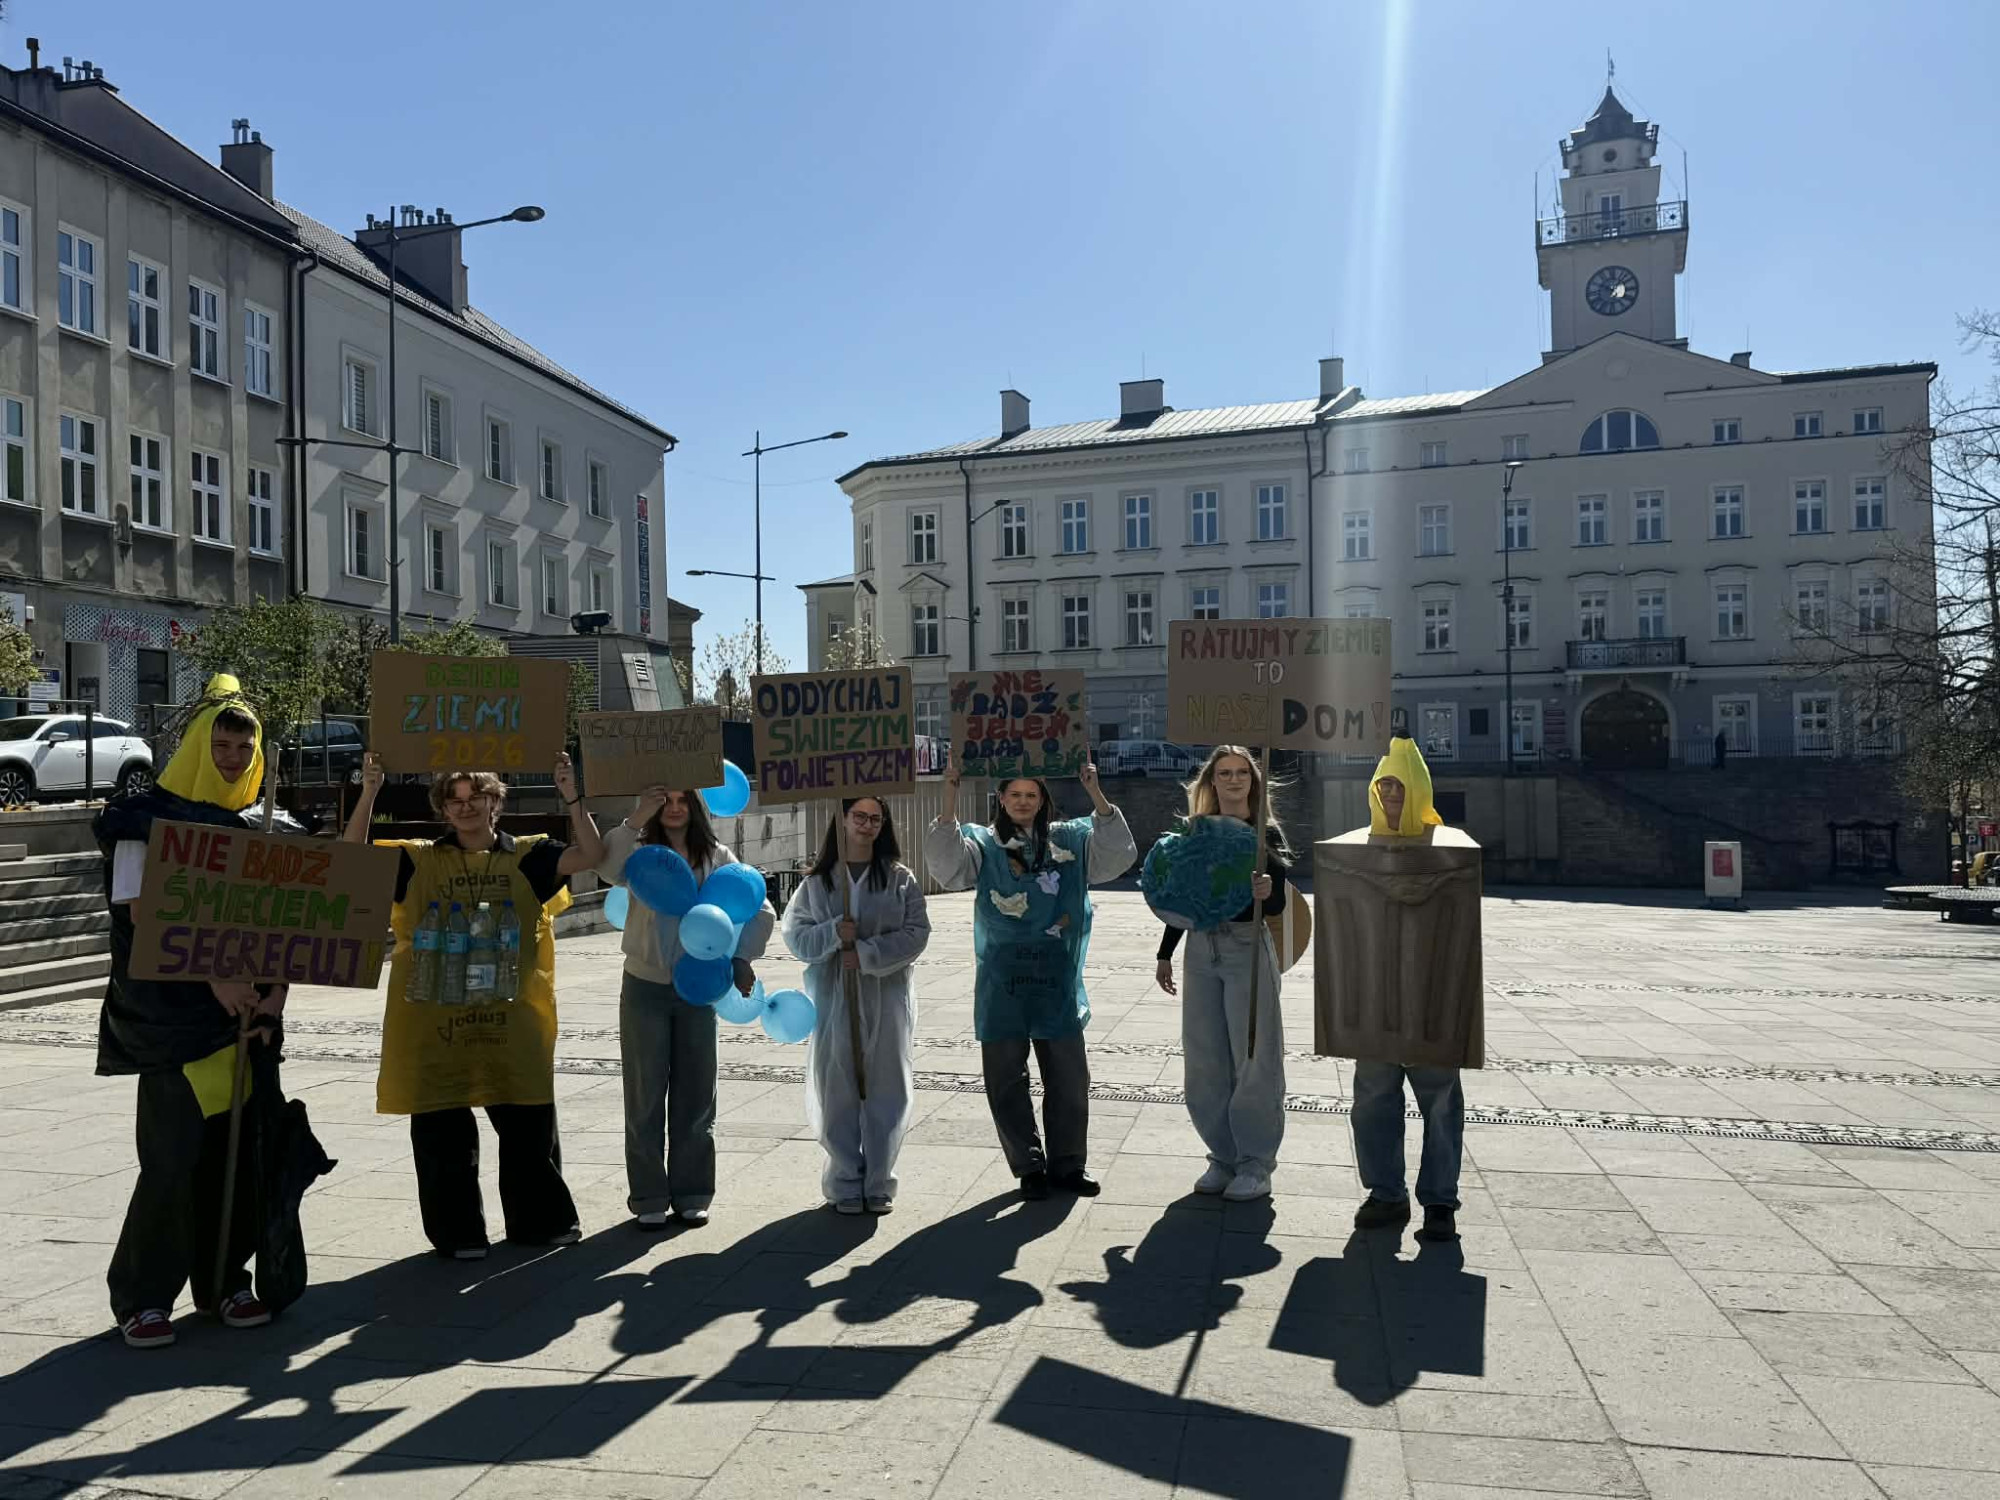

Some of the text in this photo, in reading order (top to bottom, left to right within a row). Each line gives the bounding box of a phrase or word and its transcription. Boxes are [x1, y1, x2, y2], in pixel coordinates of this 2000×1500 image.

[1180, 624, 1382, 660] RATUJMY ZIEMIĘ
[992, 670, 1043, 695] NIE
[1254, 661, 1285, 684] TO
[402, 693, 521, 733] ZIEMI
[757, 674, 901, 718] ODDYCHAJ
[1186, 693, 1269, 734] NASZ
[429, 735, 527, 766] 2026
[760, 748, 913, 792] POWIETRZEM
[160, 825, 332, 887] NIE BĄDŹ
[155, 867, 350, 930] ŚMIECIEM
